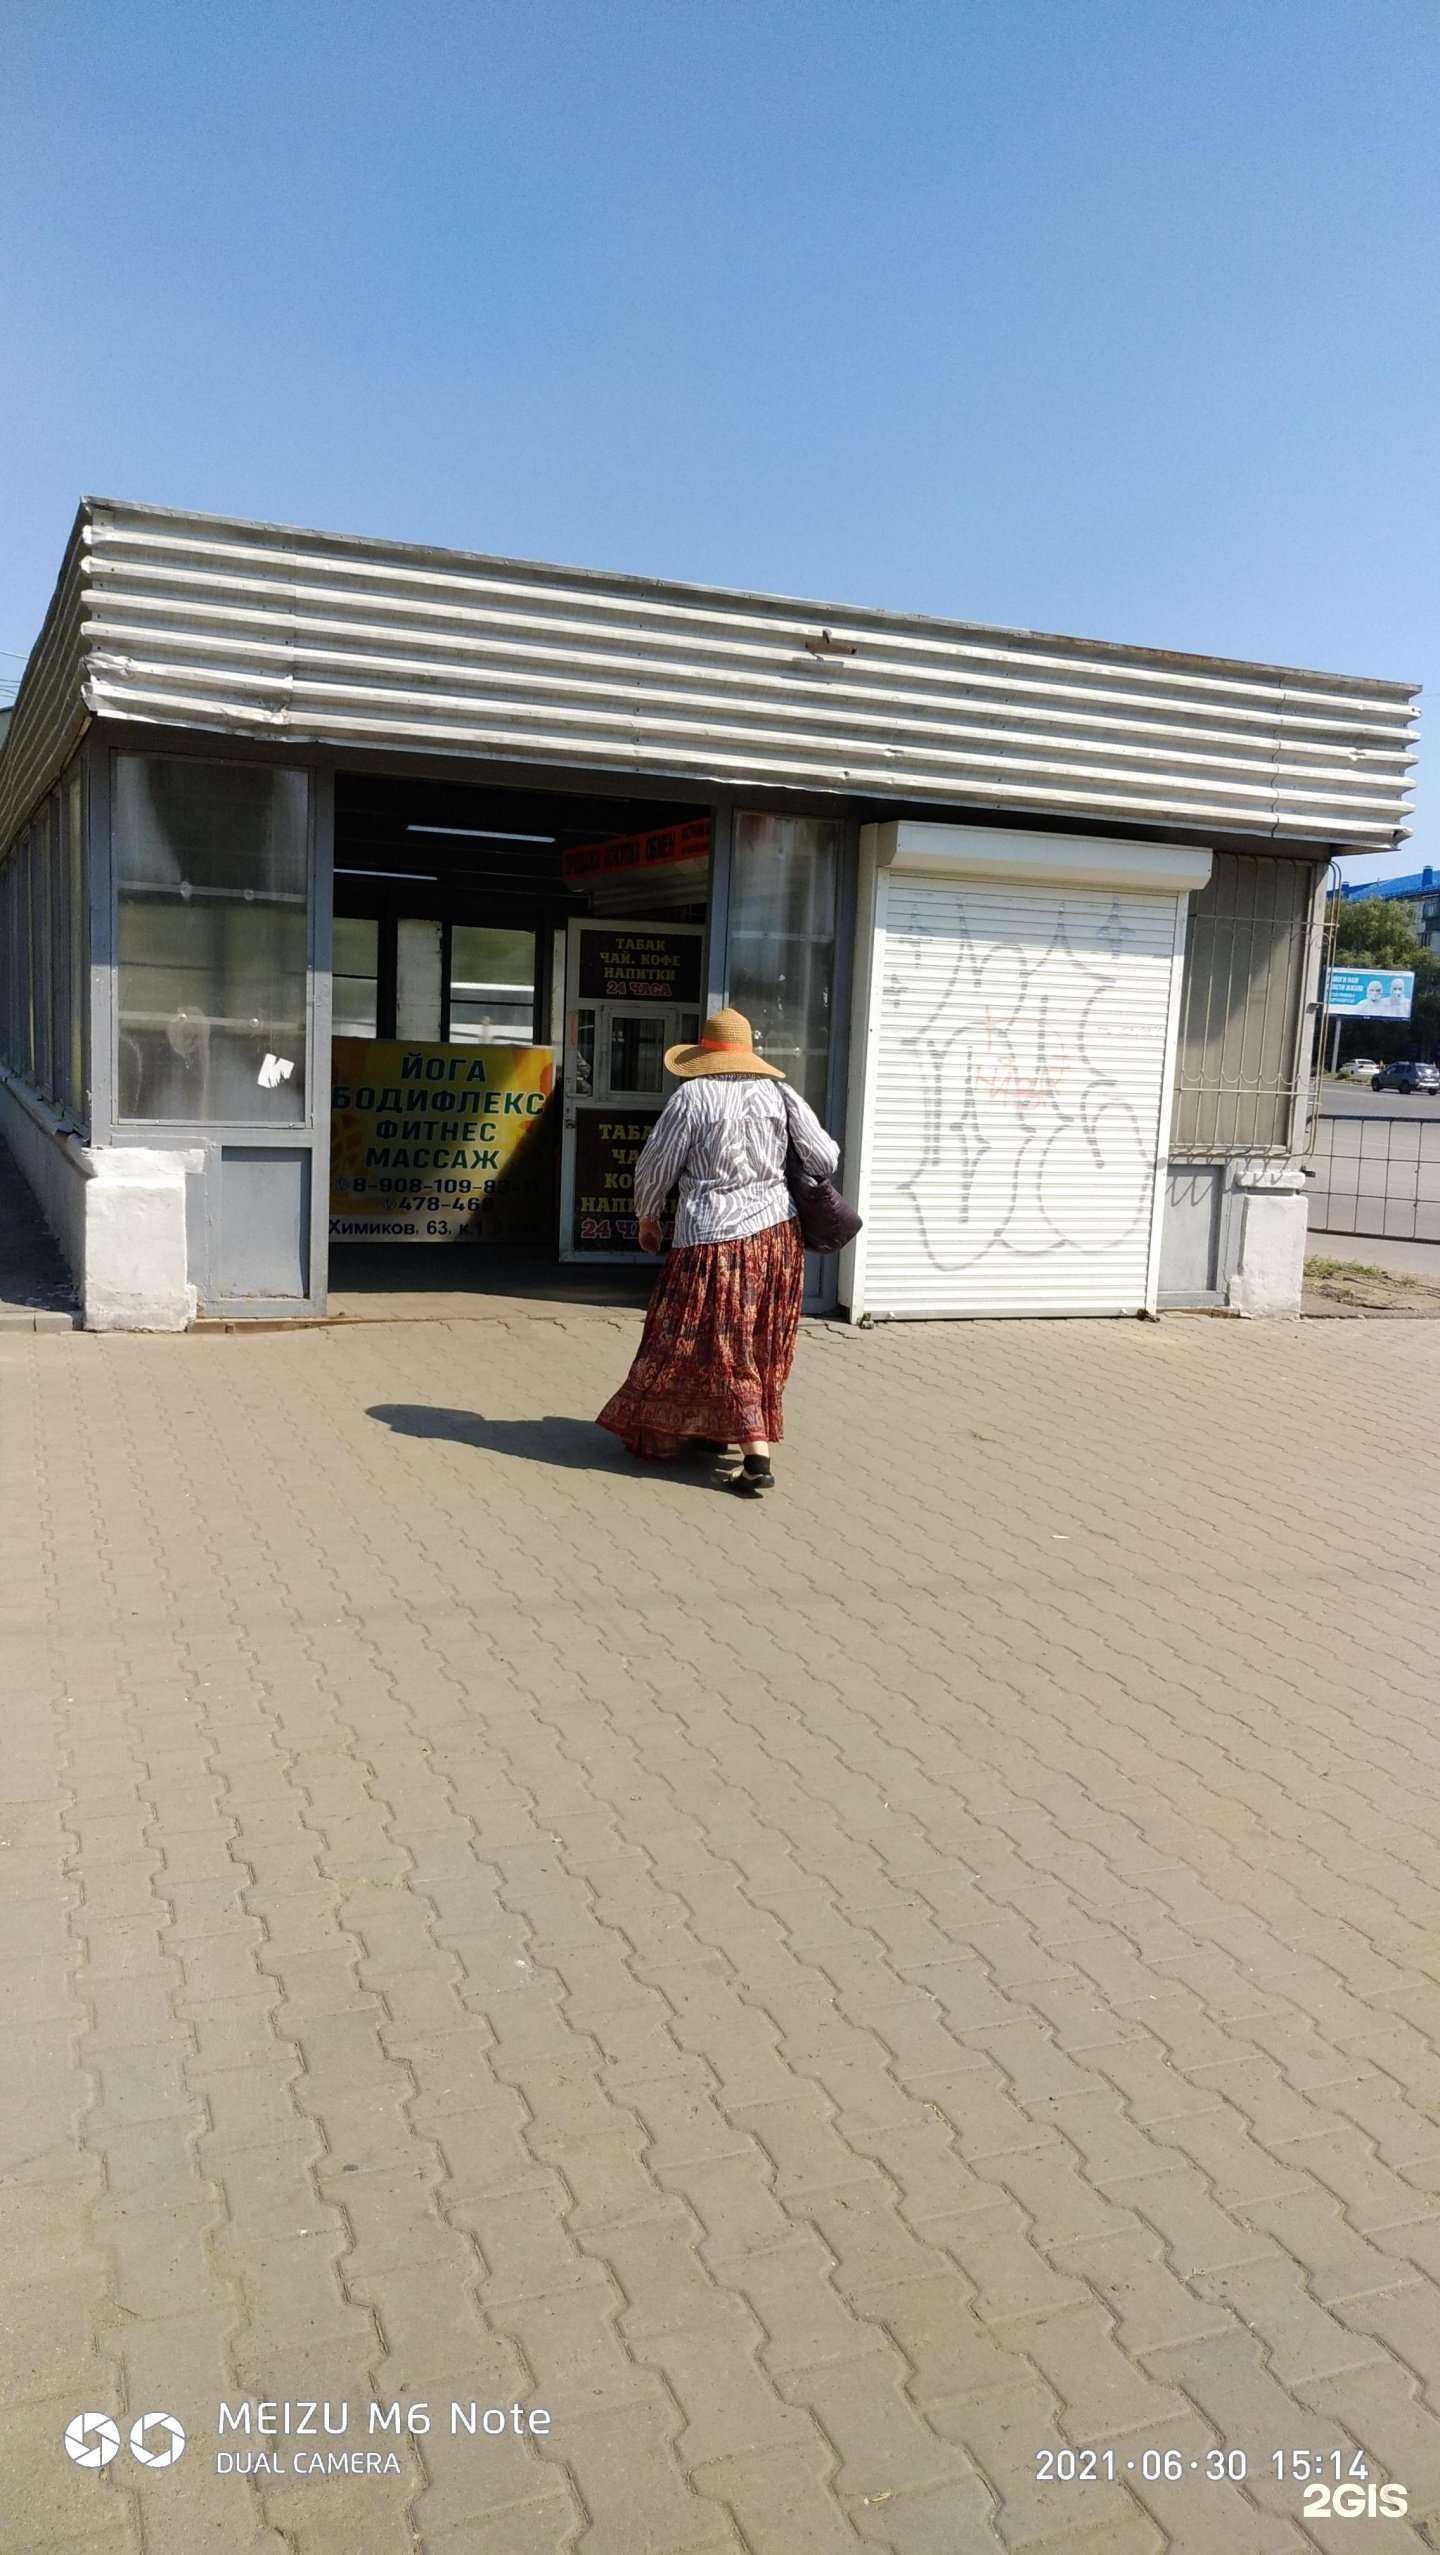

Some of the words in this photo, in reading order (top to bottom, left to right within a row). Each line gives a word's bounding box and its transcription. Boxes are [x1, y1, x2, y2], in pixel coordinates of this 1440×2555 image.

[616, 938, 666, 951] ТАБАК
[641, 954, 681, 967] КОФЕ
[603, 967, 677, 981] НАПИТКИ
[606, 980, 627, 995] 24
[629, 981, 673, 997] ЧАСА
[401, 1052, 486, 1082] ЙОГА
[331, 1086, 545, 1115] БОДИФЛЕКС
[376, 1119, 498, 1142] ФИТНЕС
[598, 1124, 653, 1140] ТАБА
[365, 1147, 501, 1170] МАССАЖ
[611, 1149, 640, 1164] ЧА
[604, 1173, 636, 1189] КО
[581, 1218, 611, 1239] 24
